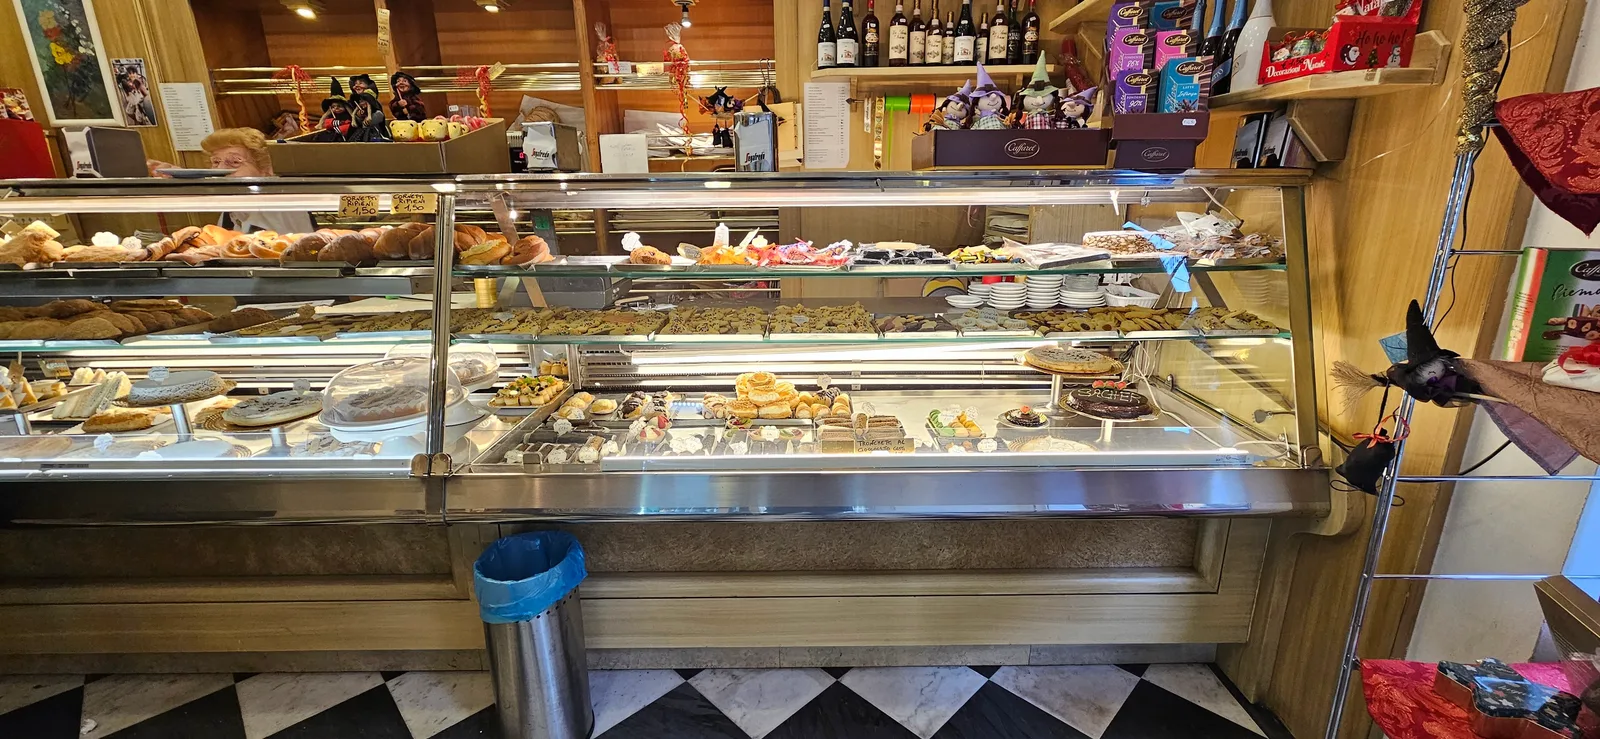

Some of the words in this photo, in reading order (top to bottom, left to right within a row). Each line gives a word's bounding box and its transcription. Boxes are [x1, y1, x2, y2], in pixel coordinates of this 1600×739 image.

[1354, 0, 1382, 15] Nata
[1356, 30, 1371, 48] Ho
[1373, 31, 1386, 46] ho
[1388, 29, 1408, 45] ho!
[1178, 61, 1205, 73] Caffarel
[1266, 65, 1301, 78] Decorazioni
[1302, 57, 1326, 71] Natale
[1008, 142, 1037, 155] Caffarel
[342, 207, 347, 215] €
[352, 206, 376, 216] 1,50
[394, 204, 400, 212] €
[404, 204, 424, 212] 1,50
[1078, 389, 1141, 404] SACHER
